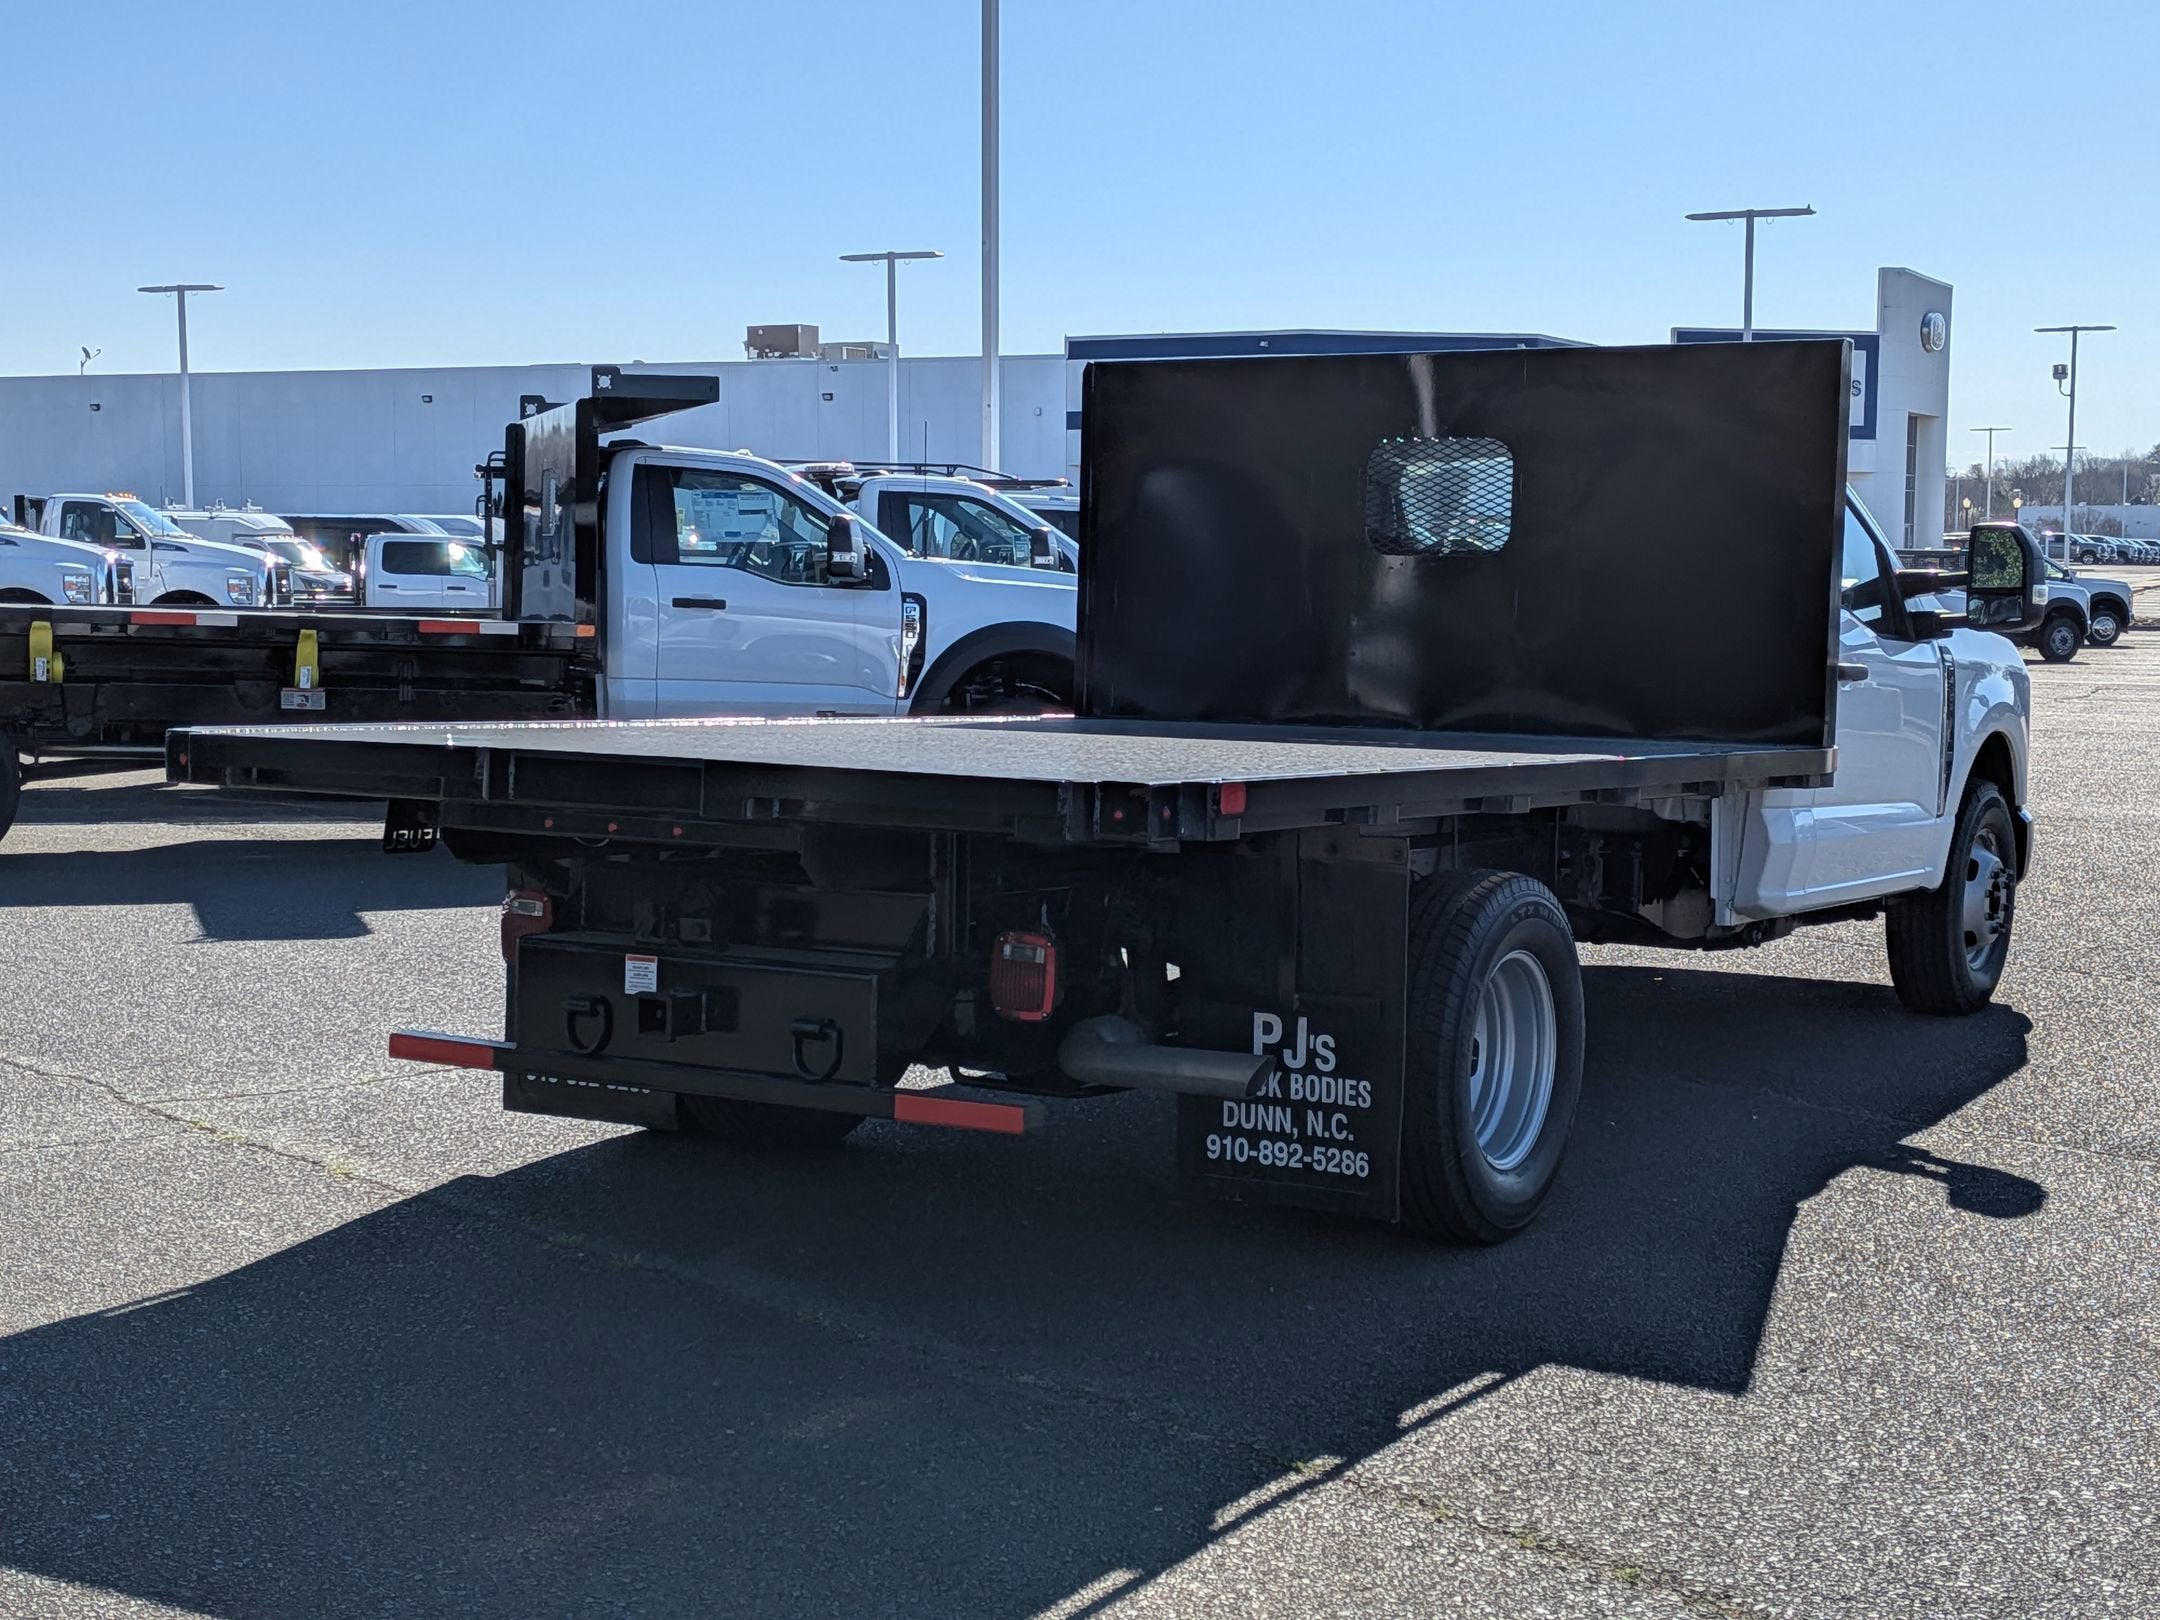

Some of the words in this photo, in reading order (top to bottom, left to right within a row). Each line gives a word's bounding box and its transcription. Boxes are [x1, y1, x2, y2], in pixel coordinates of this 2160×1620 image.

[1253, 1012, 1336, 1072] PJ'S
[1290, 1073, 1371, 1108] BODIES
[1223, 1101, 1298, 1139] DUNN,
[1307, 1110, 1354, 1141] N.C.
[1206, 1134, 1369, 1178] 910-892-5286
